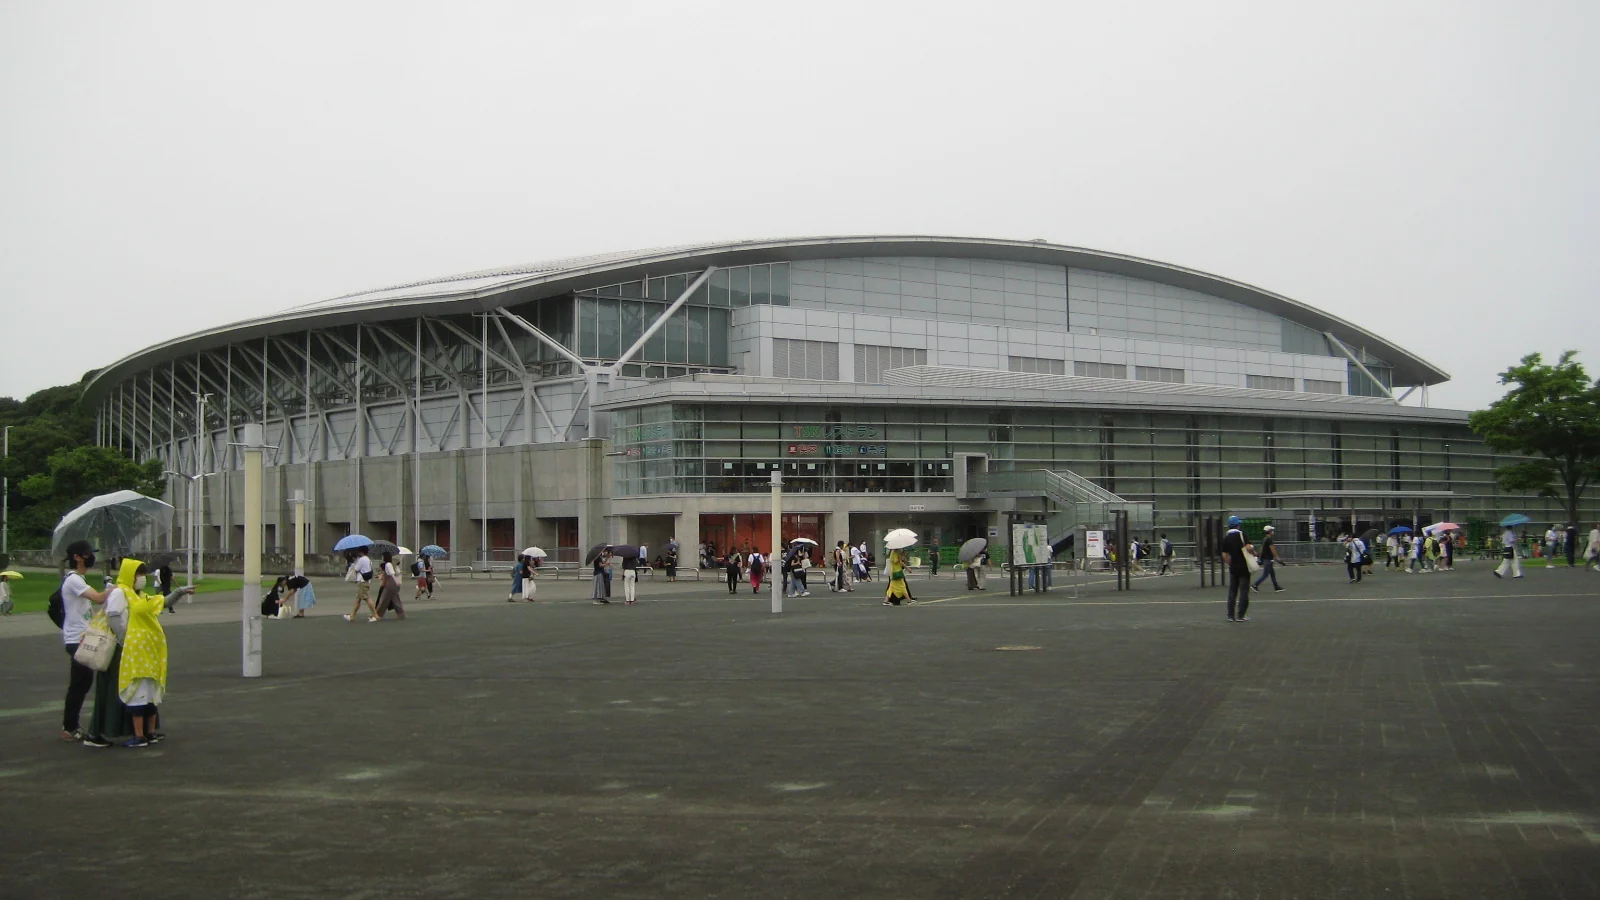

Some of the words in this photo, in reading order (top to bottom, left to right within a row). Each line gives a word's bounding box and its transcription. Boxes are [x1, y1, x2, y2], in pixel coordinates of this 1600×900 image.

[794, 425, 820, 438] TSK
[824, 425, 879, 439] レストラン
